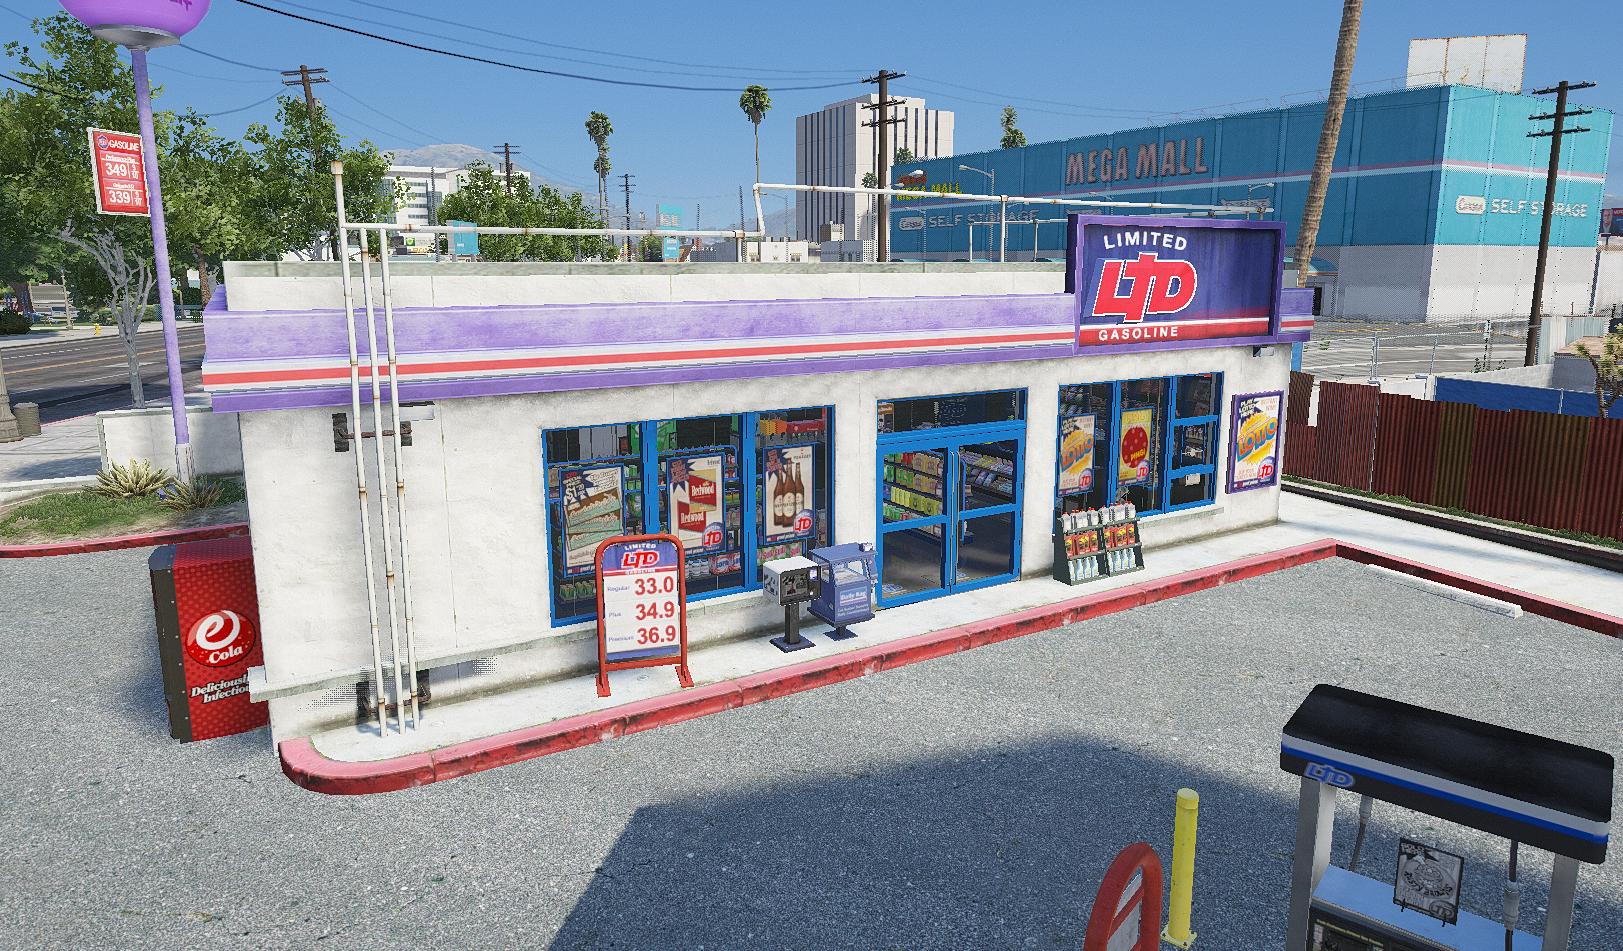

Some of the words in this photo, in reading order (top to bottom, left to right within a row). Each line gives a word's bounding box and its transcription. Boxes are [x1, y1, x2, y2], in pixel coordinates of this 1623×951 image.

[109, 139, 140, 151] GASOLINE
[105, 162, 127, 177] 349
[1065, 146, 1129, 186] MEGA
[1135, 136, 1209, 179] MALL
[108, 190, 131, 204] 339
[1491, 198, 1527, 214] SELF
[1530, 200, 1589, 218] STRAGE
[929, 214, 963, 228] SELF
[1103, 231, 1188, 250] LIMITED
[1091, 251, 1198, 323] LTD
[1098, 326, 1179, 341] GASOLINE
[1238, 403, 1255, 414] LOTTO
[1240, 398, 1254, 408] PLAY
[1236, 417, 1278, 462] LOTTO
[1060, 433, 1095, 472] LOTTO
[1130, 447, 1146, 462] PING!
[1258, 463, 1274, 480] LTD
[691, 483, 715, 497] Redwood
[680, 511, 704, 524] Redwood
[794, 517, 812, 532] LTD
[624, 543, 656, 551] LIMITED
[702, 530, 723, 547] LTD
[621, 549, 660, 569] LTD
[634, 576, 674, 596] 33.0
[635, 601, 675, 621] 34.9
[636, 625, 676, 645] 36.9
[208, 644, 243, 664] Cola
[190, 673, 249, 698] Deliciousl
[1304, 762, 1355, 787] LTD
